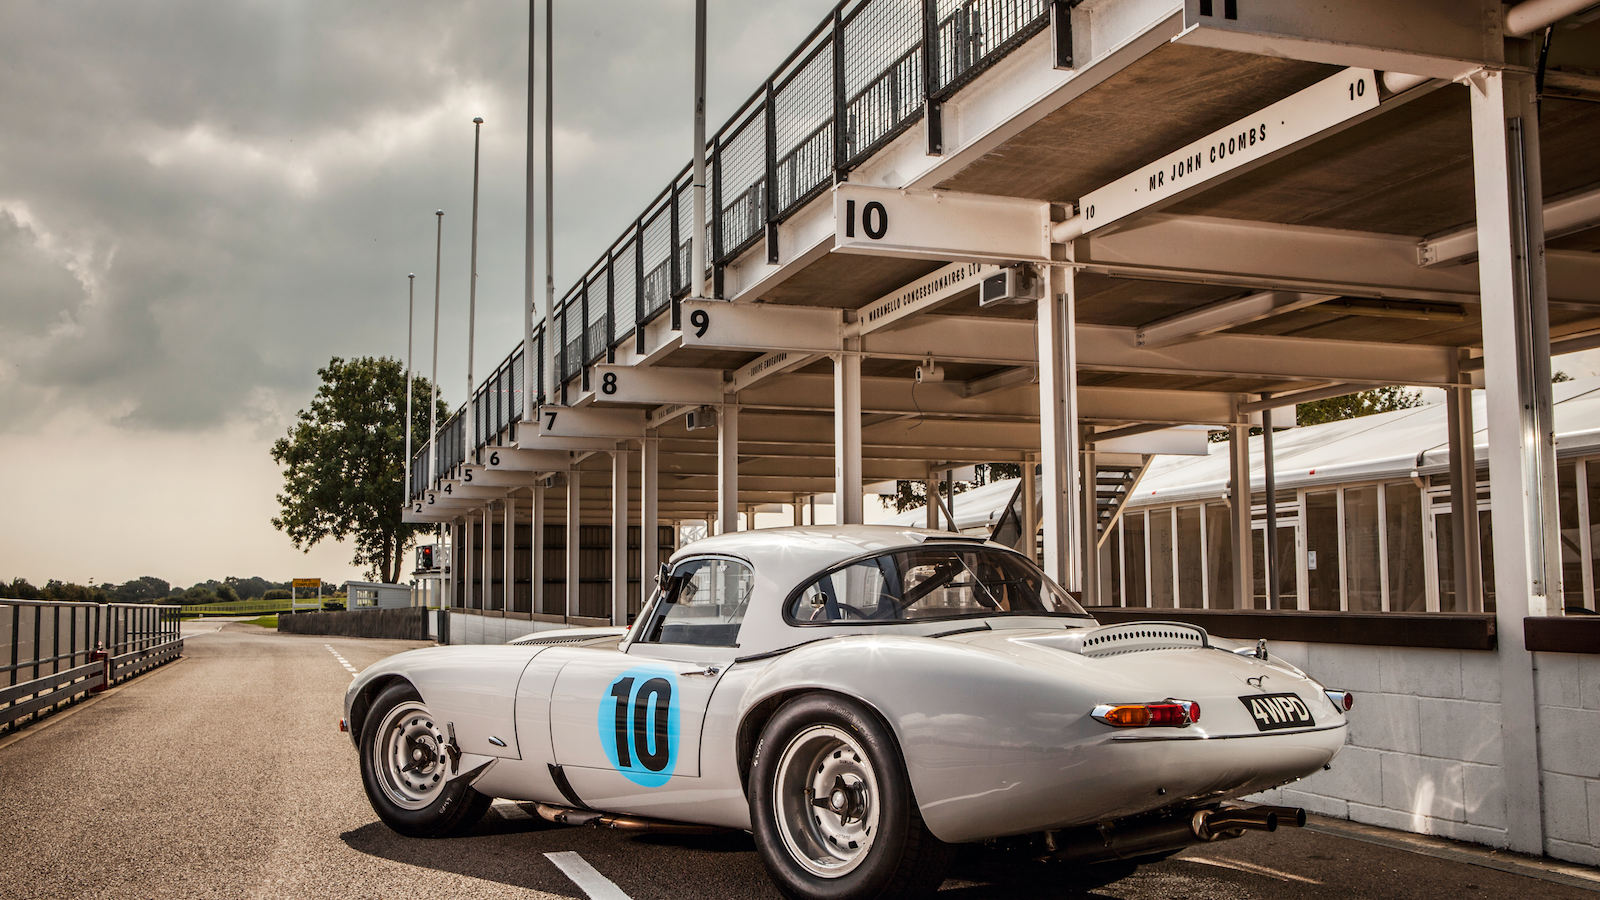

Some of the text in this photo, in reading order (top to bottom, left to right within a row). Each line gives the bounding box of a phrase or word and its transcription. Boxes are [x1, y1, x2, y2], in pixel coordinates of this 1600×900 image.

[1349, 78, 1365, 101] 10
[1149, 123, 1266, 192] MR JOHN COOMBS
[845, 199, 888, 240] 10
[1085, 204, 1095, 220] 10
[869, 297, 900, 323] MARANELLO
[903, 267, 965, 306] CONCESSIONAIRES
[690, 309, 710, 338] 9
[602, 372, 617, 395] 8
[545, 412, 558, 431] 7
[489, 451, 500, 466] 6
[464, 468, 473, 482] 5
[427, 494, 435, 505] 3
[443, 483, 452, 495] 4
[415, 503, 422, 513] 2
[1250, 696, 1310, 724] 4WPD
[610, 677, 672, 772] 10
